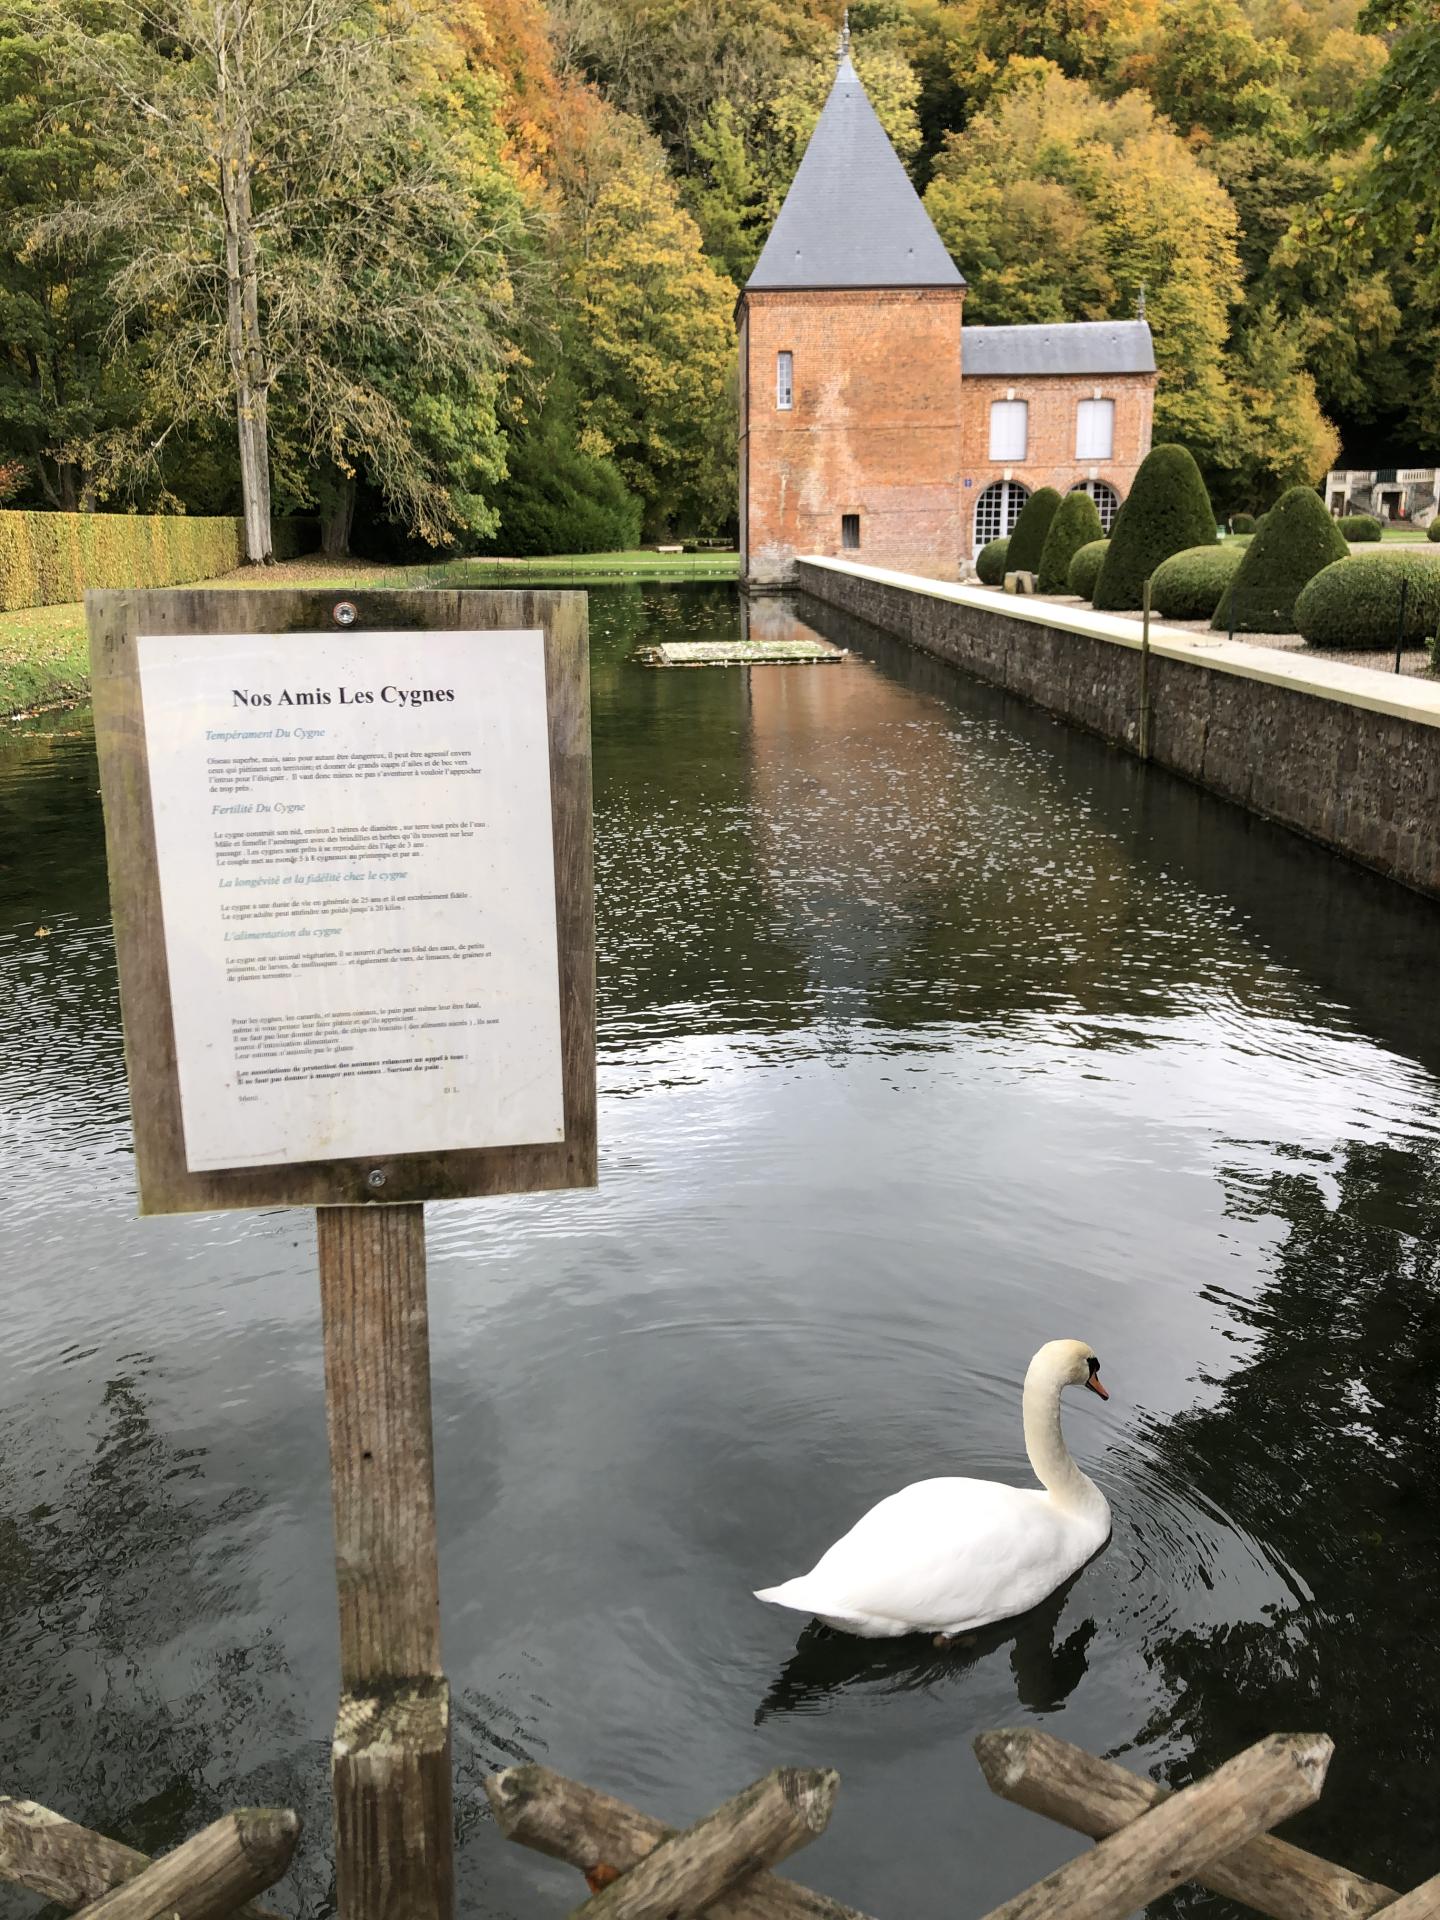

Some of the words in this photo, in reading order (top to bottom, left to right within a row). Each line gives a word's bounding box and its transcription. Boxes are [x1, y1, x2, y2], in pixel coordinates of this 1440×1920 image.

[232, 689, 272, 707] Nos
[277, 688, 332, 706] Amis
[338, 687, 374, 705] Les
[380, 685, 455, 707] Cygnes
[205, 729, 274, 743] Tempérament
[275, 728, 291, 738] Du
[293, 727, 326, 740] Cygne
[211, 803, 254, 815] Fertilité
[255, 803, 272, 813] Du
[274, 802, 307, 815] Cygne
[218, 878, 233, 888] La
[234, 875, 282, 890] longévité
[283, 876, 293, 885] et
[294, 874, 305, 884] la
[307, 872, 342, 886] fidélité
[343, 871, 366, 882] chez
[368, 870, 378, 880] le
[380, 872, 408, 882] cygne
[223, 928, 297, 941] L'alimentation
[298, 927, 312, 937] du
[314, 928, 343, 939] cygne
